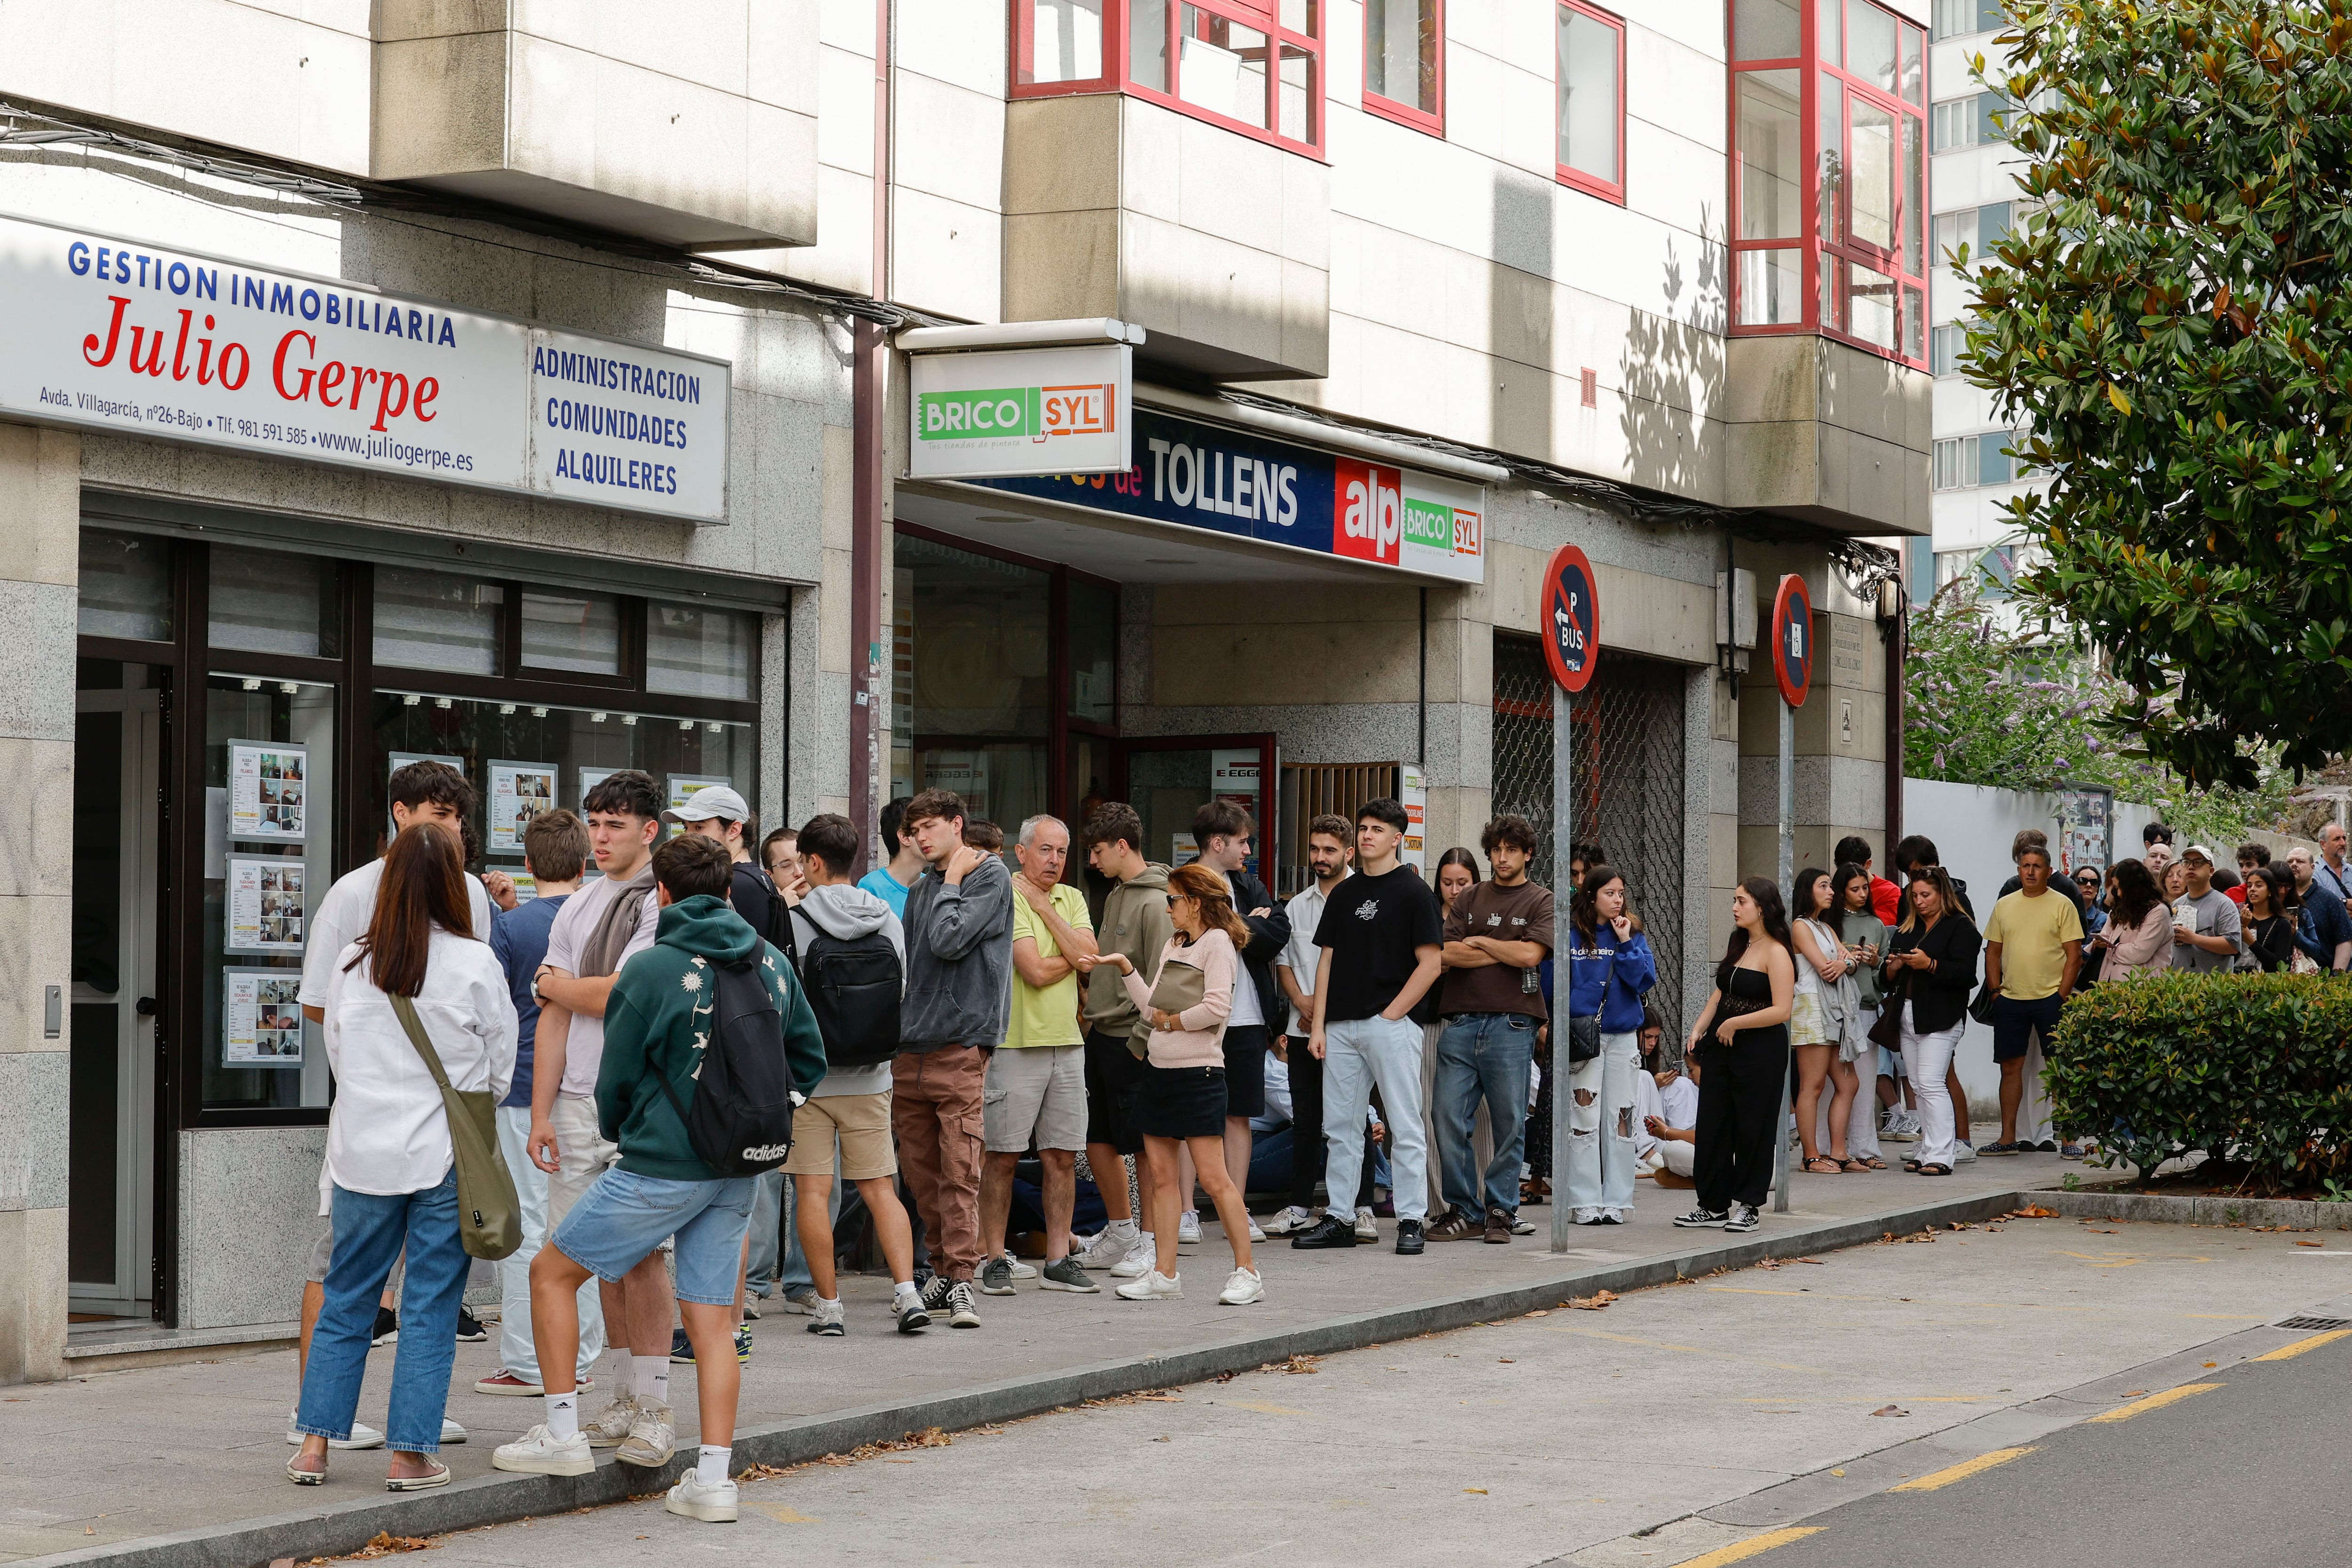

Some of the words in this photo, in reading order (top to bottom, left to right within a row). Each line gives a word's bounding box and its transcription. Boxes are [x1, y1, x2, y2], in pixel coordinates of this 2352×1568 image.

[69, 242, 217, 301] GESTION
[232, 274, 456, 348] INMOBILIARIA
[83, 295, 250, 391] Julio
[272, 330, 439, 432] Gerpe
[533, 347, 700, 405] ADMINISTRACION
[548, 398, 687, 449] COMUNIDADES
[927, 399, 1021, 431] BRICO
[1046, 396, 1099, 425] SYL
[40, 387, 72, 407] Avda.
[77, 392, 143, 422] Villagarcía,
[147, 405, 202, 430] nº26-Bajo
[217, 416, 234, 433] Tlf.
[238, 420, 259, 438] 981
[263, 423, 283, 441] 591
[286, 427, 307, 445] 585
[319, 432, 473, 471] www.juliogerpe.es
[928, 442, 941, 450] Tus
[944, 440, 975, 449] tiendas
[991, 440, 1020, 450] pintura
[556, 448, 677, 495] ALQUILERES
[1148, 438, 1298, 527] TOLLENS
[1344, 470, 1400, 558] alp
[1406, 508, 1446, 540] BRICO
[1455, 518, 1476, 548] SYL
[1570, 592, 1577, 613] P
[1562, 626, 1583, 650] BUS
[1408, 840, 1422, 849] JOTUN
[742, 1144, 787, 1162] adidas
